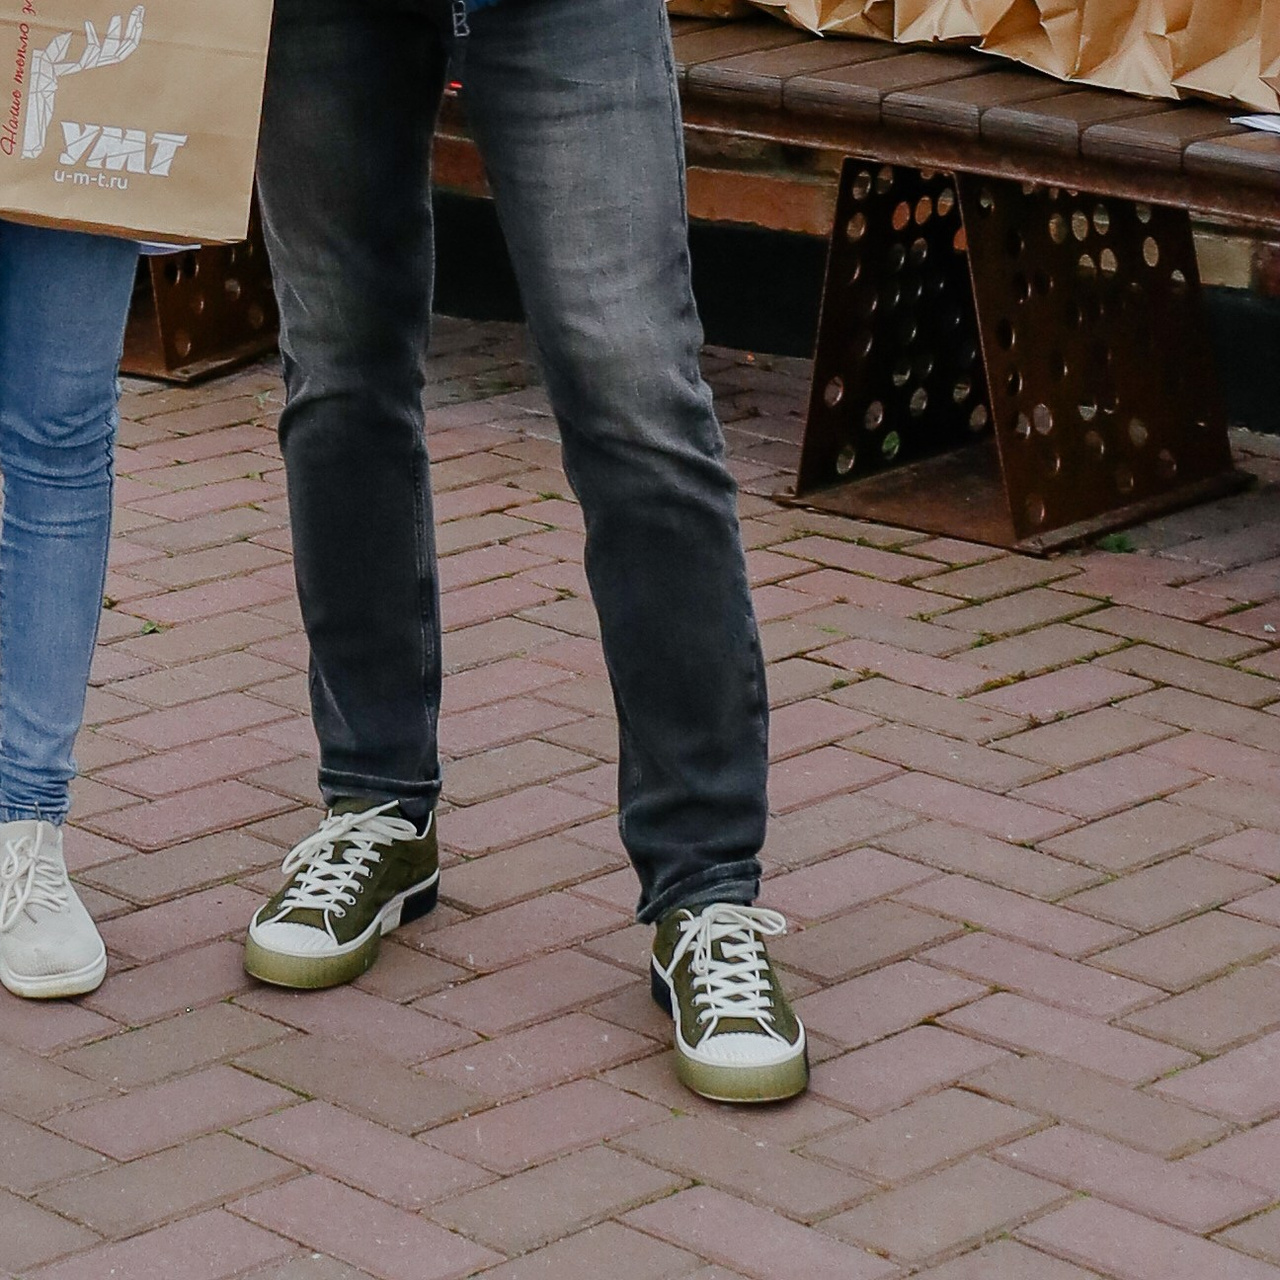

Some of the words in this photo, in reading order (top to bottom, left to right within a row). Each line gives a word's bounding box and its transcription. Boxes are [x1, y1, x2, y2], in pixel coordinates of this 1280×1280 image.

[0, 89, 22, 155] Наше
[13, 23, 29, 84] тепло
[59, 121, 188, 176] УМТ
[54, 169, 128, 190] u-m-t.ru
